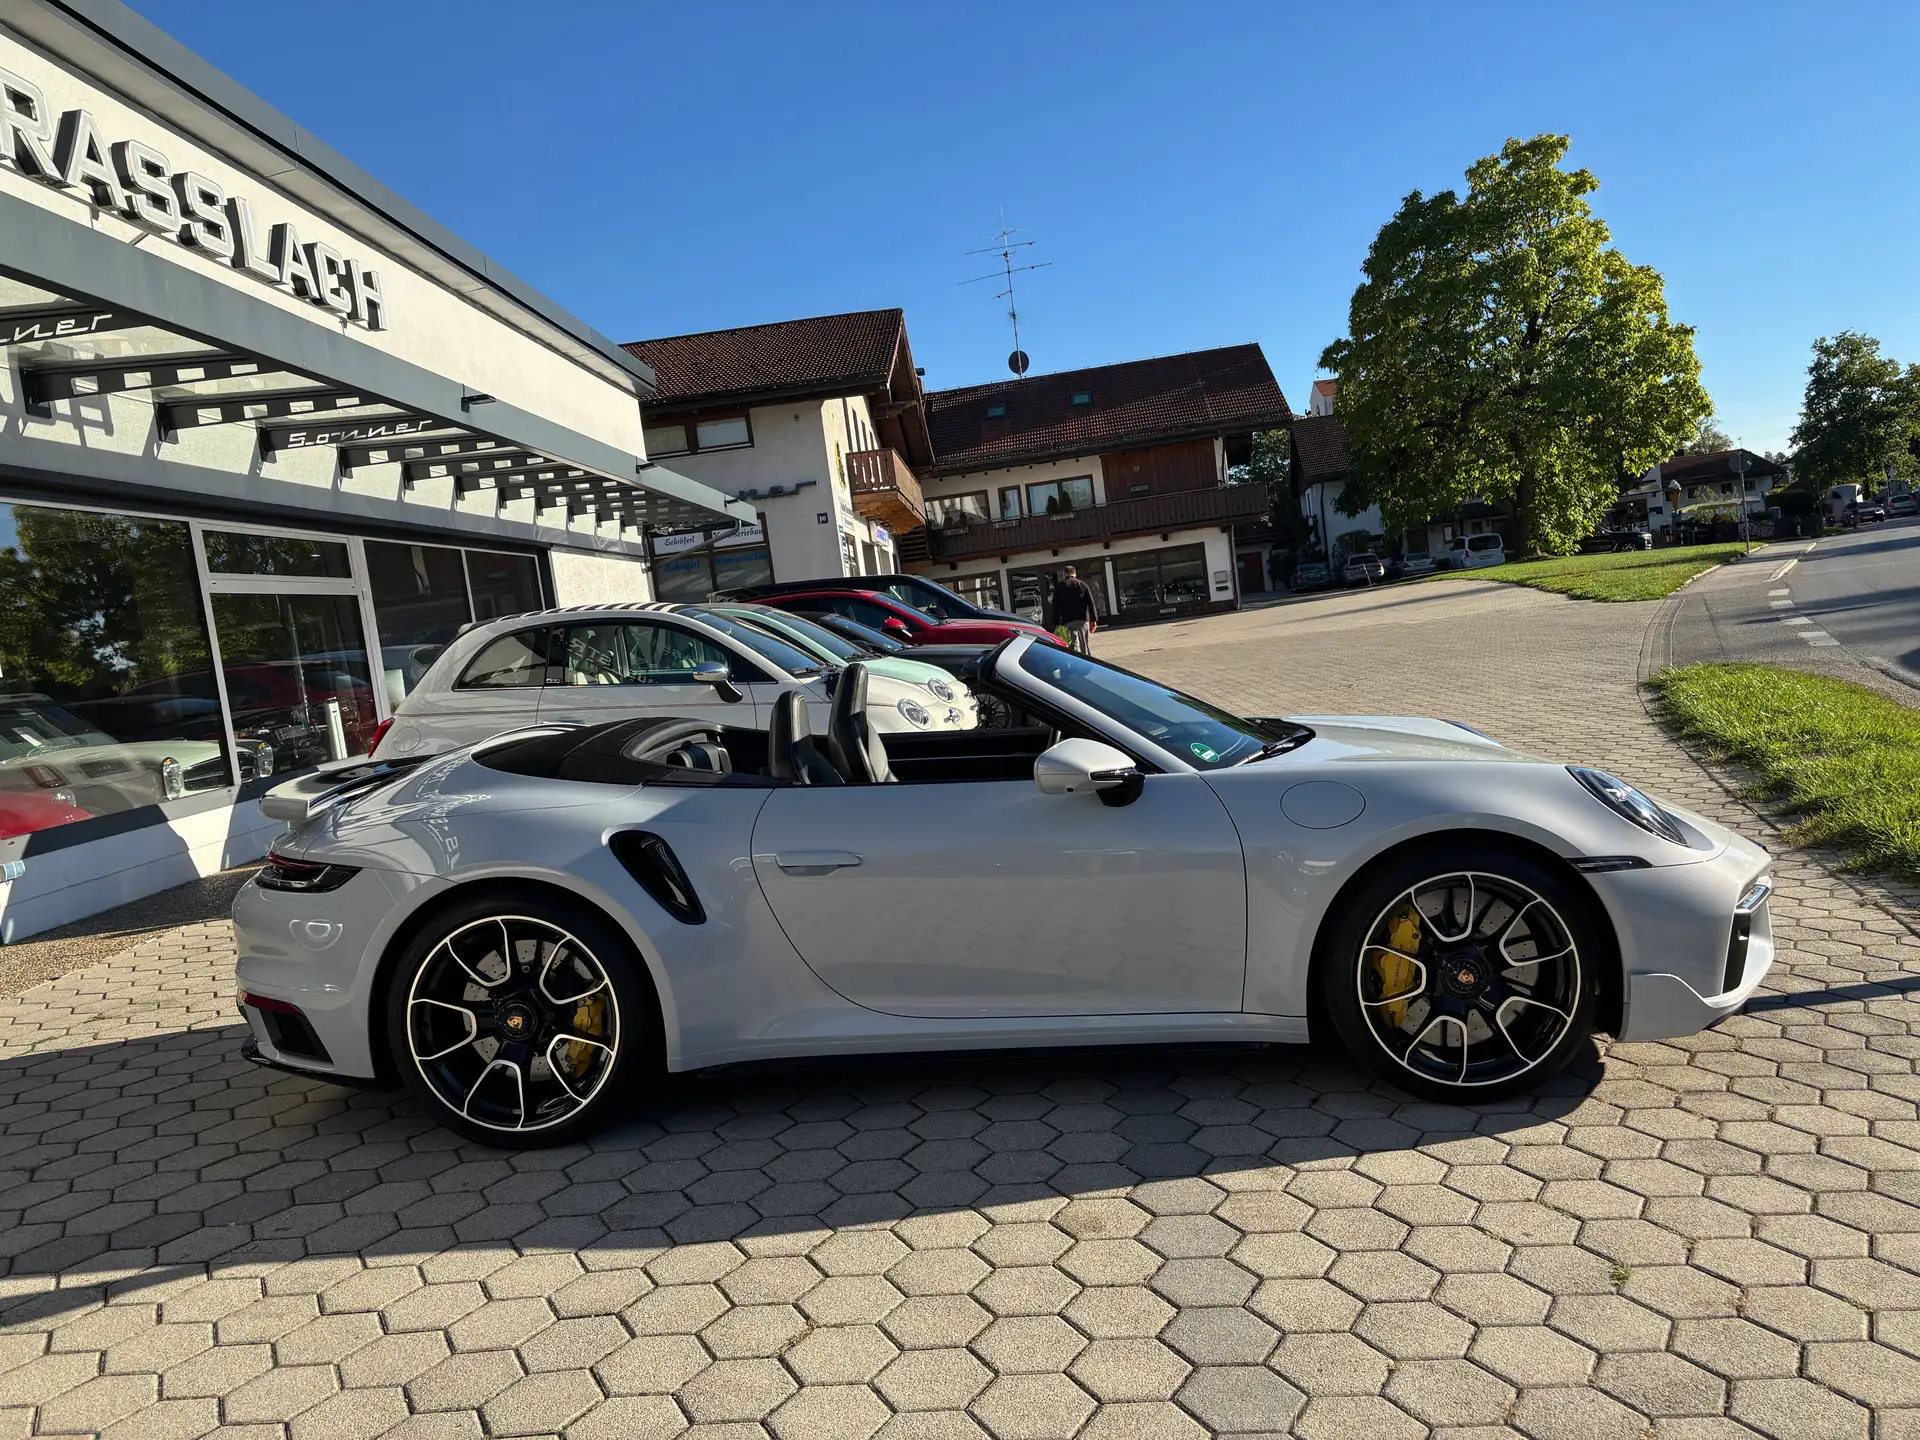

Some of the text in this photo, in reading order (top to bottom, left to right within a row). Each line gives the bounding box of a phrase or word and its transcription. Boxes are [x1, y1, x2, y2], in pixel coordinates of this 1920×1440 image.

[0, 66, 388, 331] RASSLACH
[287, 420, 433, 448] Sonner
[664, 535, 695, 546] Schröferl
